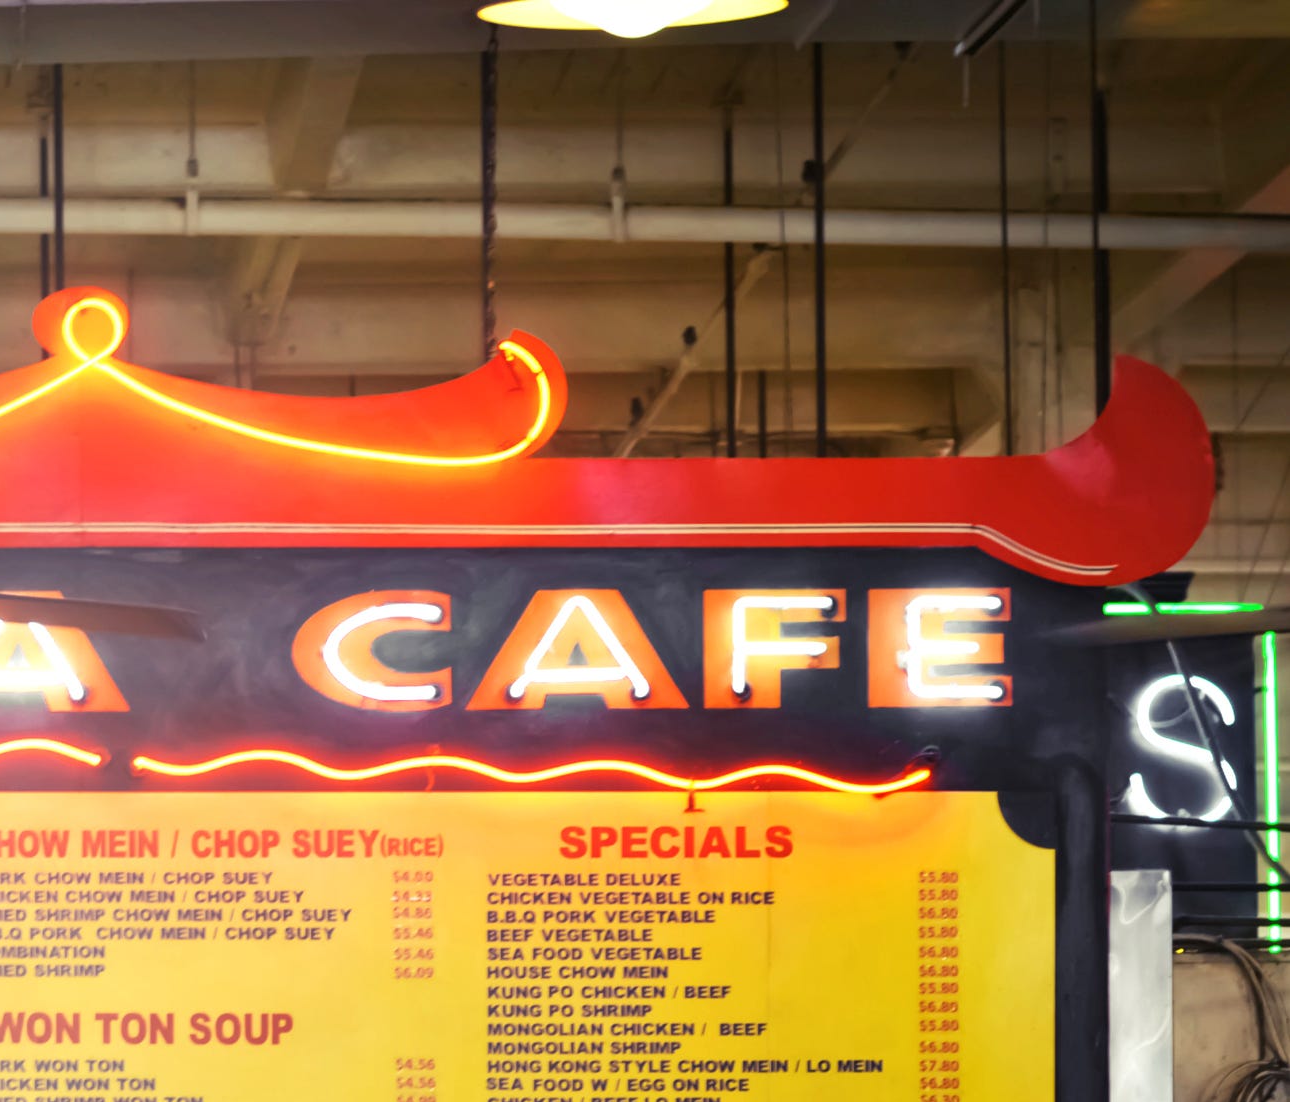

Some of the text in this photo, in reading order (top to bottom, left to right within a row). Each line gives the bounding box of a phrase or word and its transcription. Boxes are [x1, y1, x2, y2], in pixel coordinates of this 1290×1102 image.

[291, 588, 1012, 713] CAFE
[1129, 672, 1238, 824] S
[82, 830, 159, 858] MEIN
[191, 830, 280, 858] CHOP
[560, 826, 793, 859] SPECIALS
[489, 873, 680, 886] VEGETABLE DELUXE
[919, 871, 958, 884] $5.80
[487, 891, 774, 905] CHICKEN VEGETABLE ON RICE
[919, 888, 958, 901] $5.80
[543, 911, 595, 923] PORK
[605, 910, 715, 923] VEGETABLE
[918, 907, 958, 919] $6.80
[487, 929, 652, 942] BEEF VEGETABLE
[918, 926, 958, 939] $5.80
[488, 947, 702, 960] SEA FOOD VEGETABLE
[919, 946, 959, 958] $6.80
[35, 964, 105, 977] SHRIMP
[487, 966, 668, 979] HOUSE CHOW MEIN
[919, 964, 959, 978] $6.80
[919, 982, 958, 995] $5.80
[488, 1005, 652, 1017] KUNG PO SHRIMP
[919, 1000, 958, 1013] $6.80
[95, 1012, 174, 1045] TON
[190, 1013, 293, 1045] SOUP
[919, 1019, 959, 1032] $5.80
[488, 1042, 681, 1055] MONGOLIAN SHRIMP
[919, 1041, 959, 1054] $6.80
[35, 1060, 78, 1072] WON
[86, 1060, 124, 1072] TON
[919, 1060, 959, 1072] $7.80
[66, 1078, 110, 1091] WON
[116, 1078, 155, 1091] TON
[920, 1077, 960, 1090] $6.80
